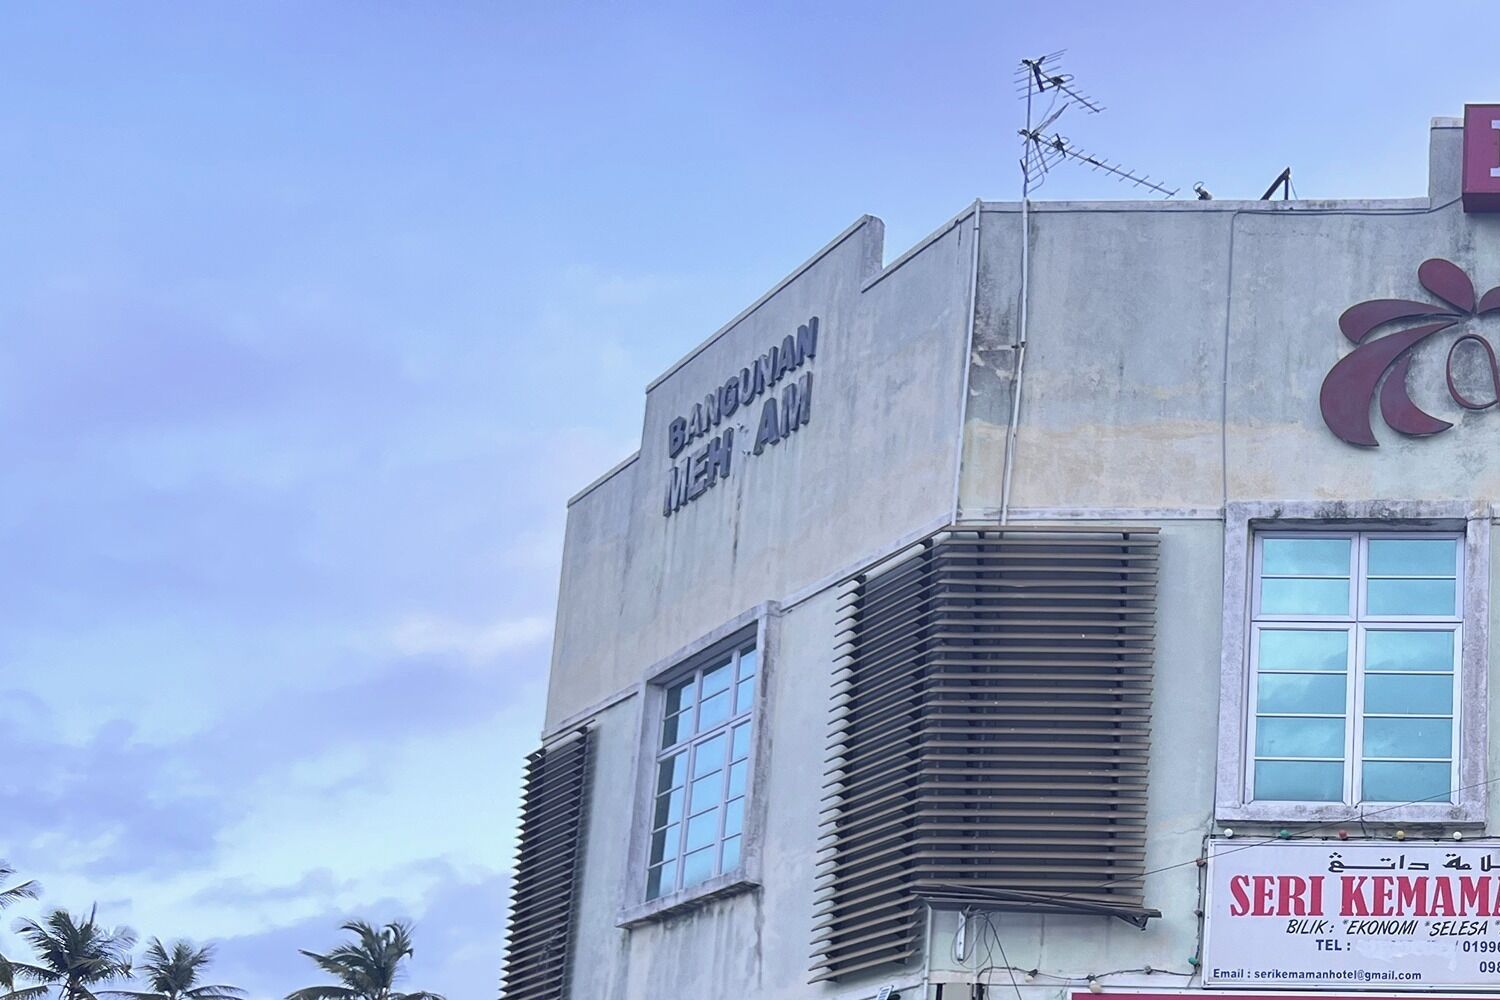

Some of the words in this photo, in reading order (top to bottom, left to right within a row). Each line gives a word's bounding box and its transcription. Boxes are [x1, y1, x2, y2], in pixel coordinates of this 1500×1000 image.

[668, 316, 819, 459] BANGUNAN
[662, 427, 735, 518] MEH
[1230, 875, 1325, 917] SERI
[1254, 969, 1422, 981] serikemamanhotel@gmail.com
